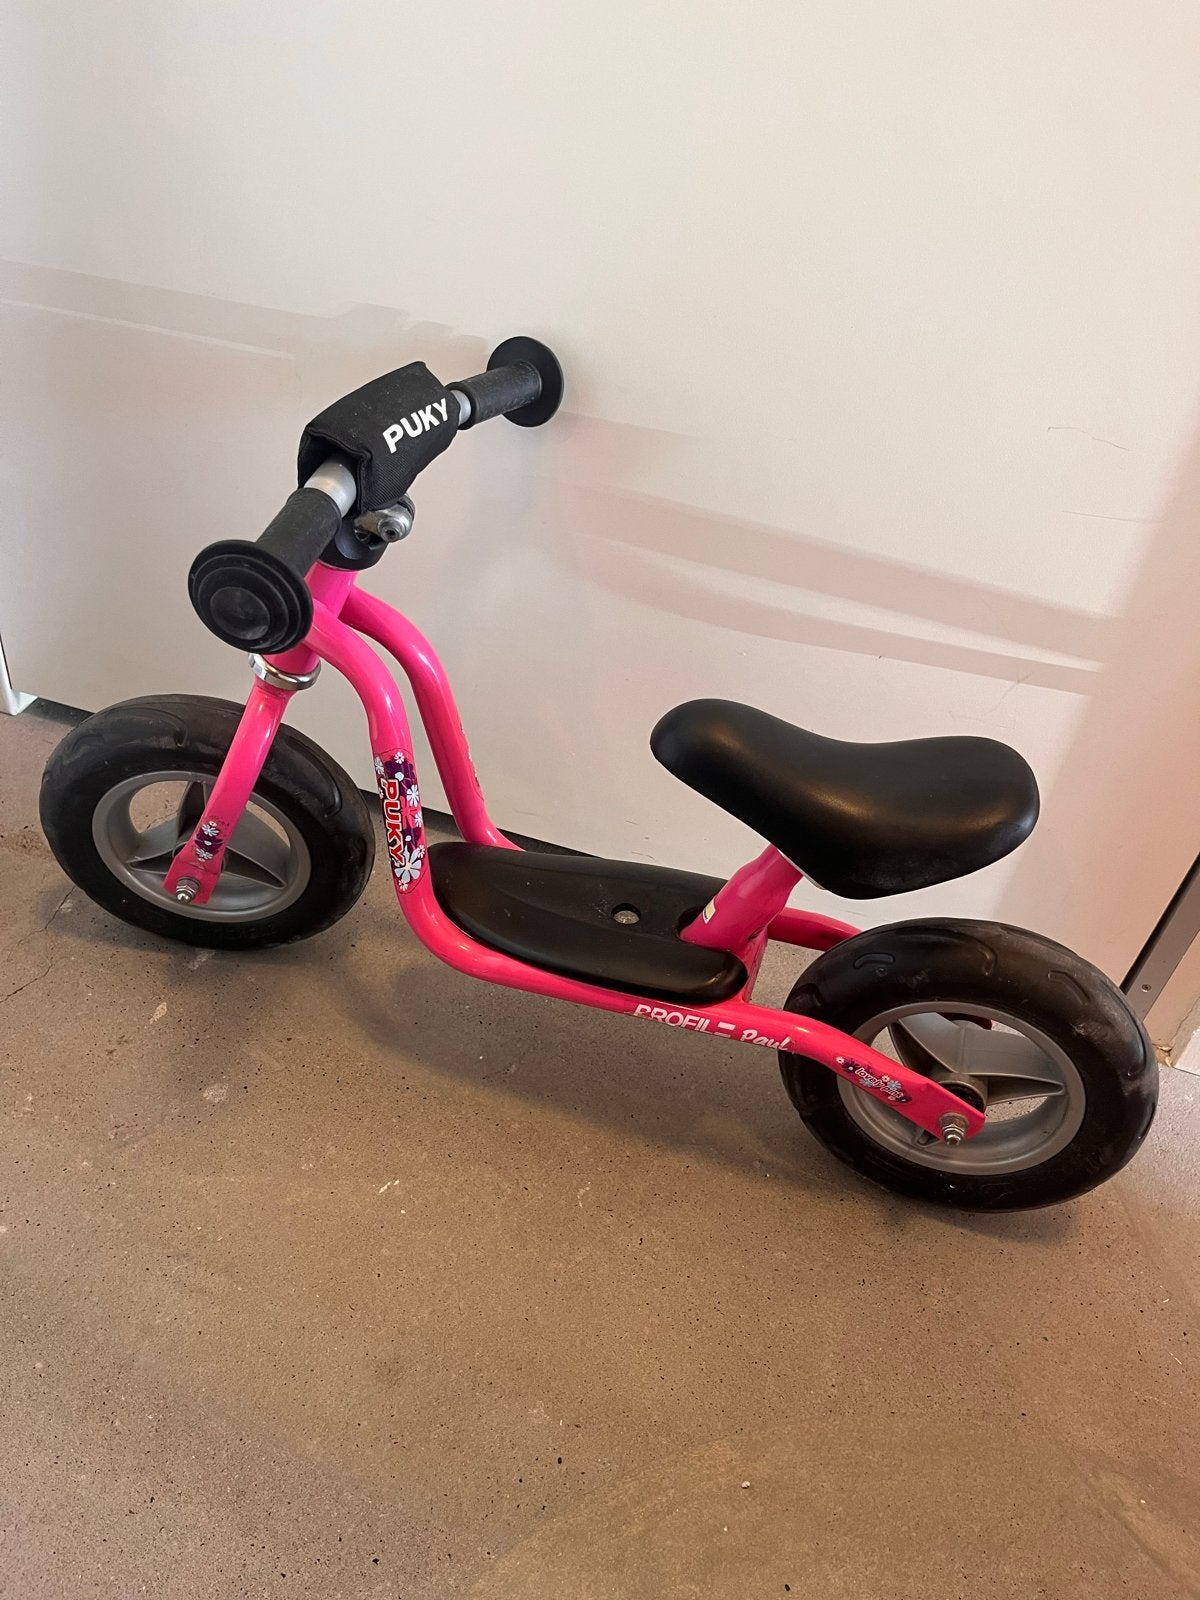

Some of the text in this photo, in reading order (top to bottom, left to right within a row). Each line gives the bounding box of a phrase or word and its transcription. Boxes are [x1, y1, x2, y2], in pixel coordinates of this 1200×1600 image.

[382, 397, 448, 454] PUKY
[380, 778, 405, 866] PUKY
[855, 1067, 885, 1088] lovely
